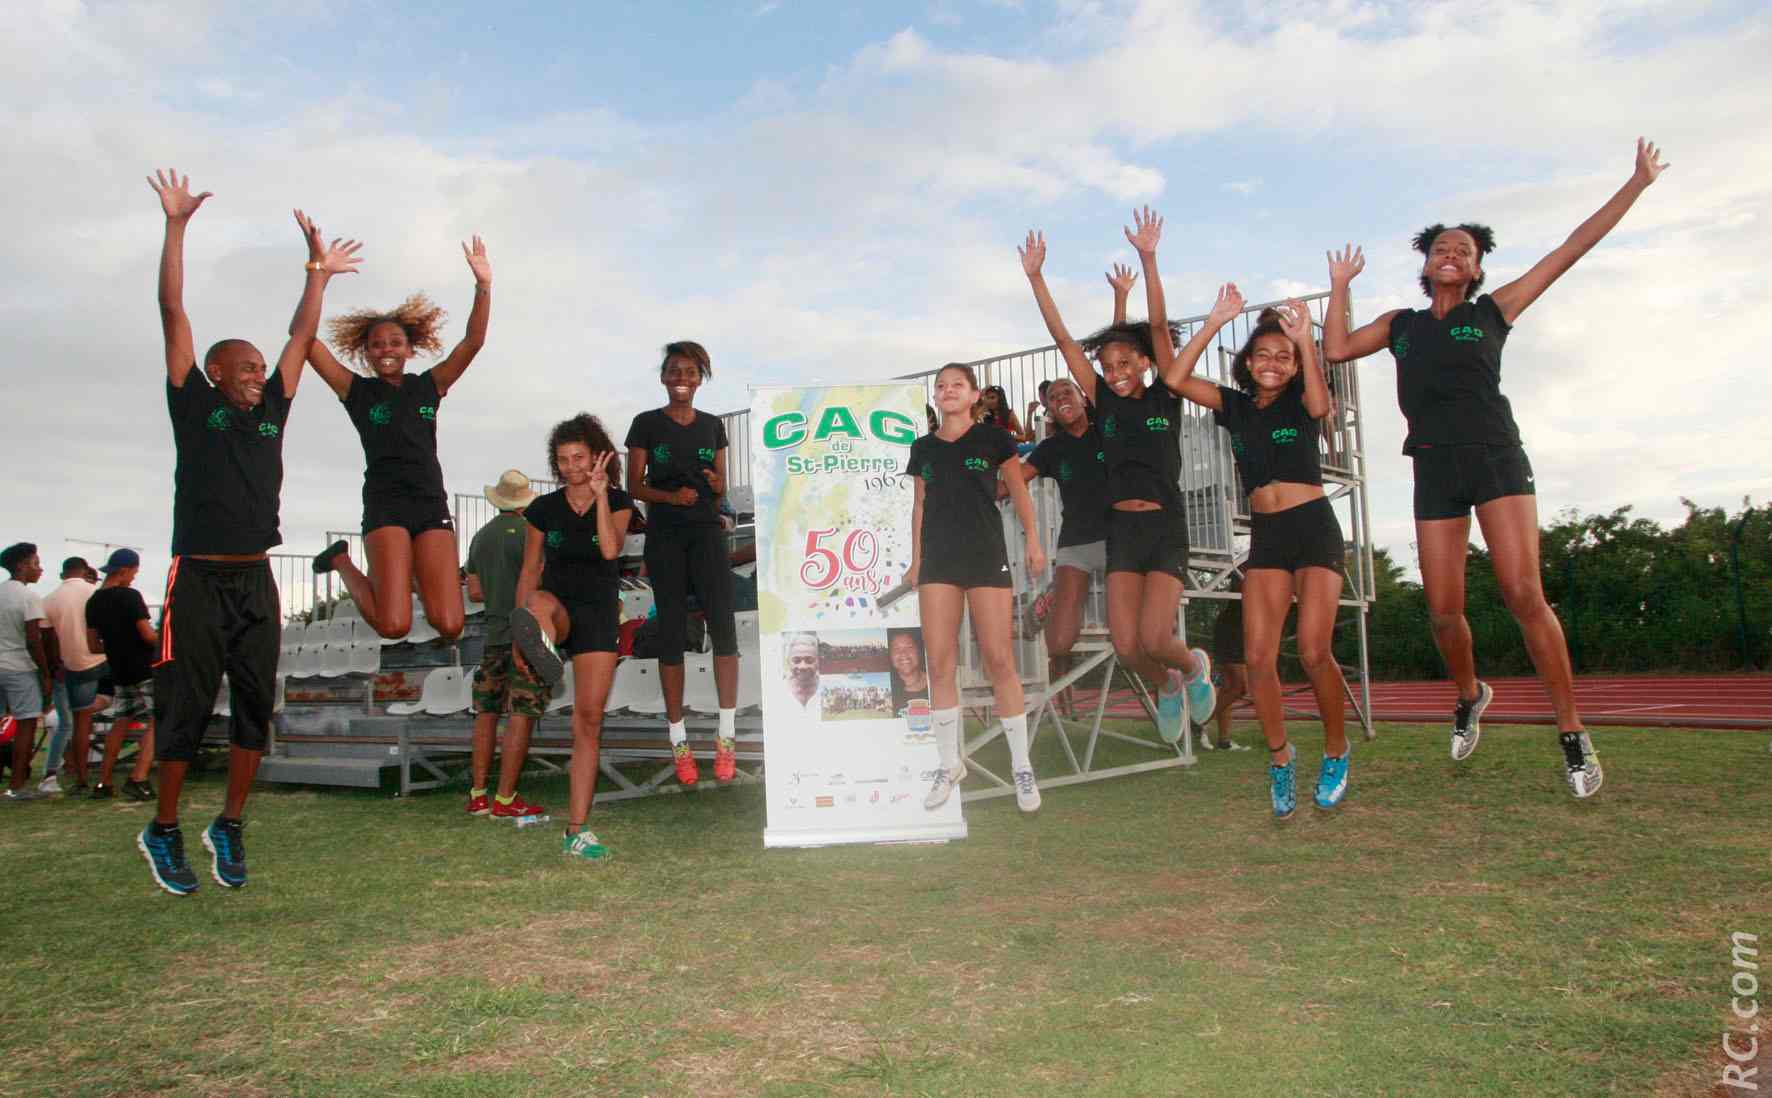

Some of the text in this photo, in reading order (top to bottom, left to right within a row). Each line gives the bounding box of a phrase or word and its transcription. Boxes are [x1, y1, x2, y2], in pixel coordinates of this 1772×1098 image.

[762, 405, 918, 450] CAG
[1146, 417, 1169, 426] CAG
[831, 439, 850, 452] de
[787, 454, 898, 474] St-Pierre
[800, 527, 881, 591] 50
[843, 569, 881, 595] ans
